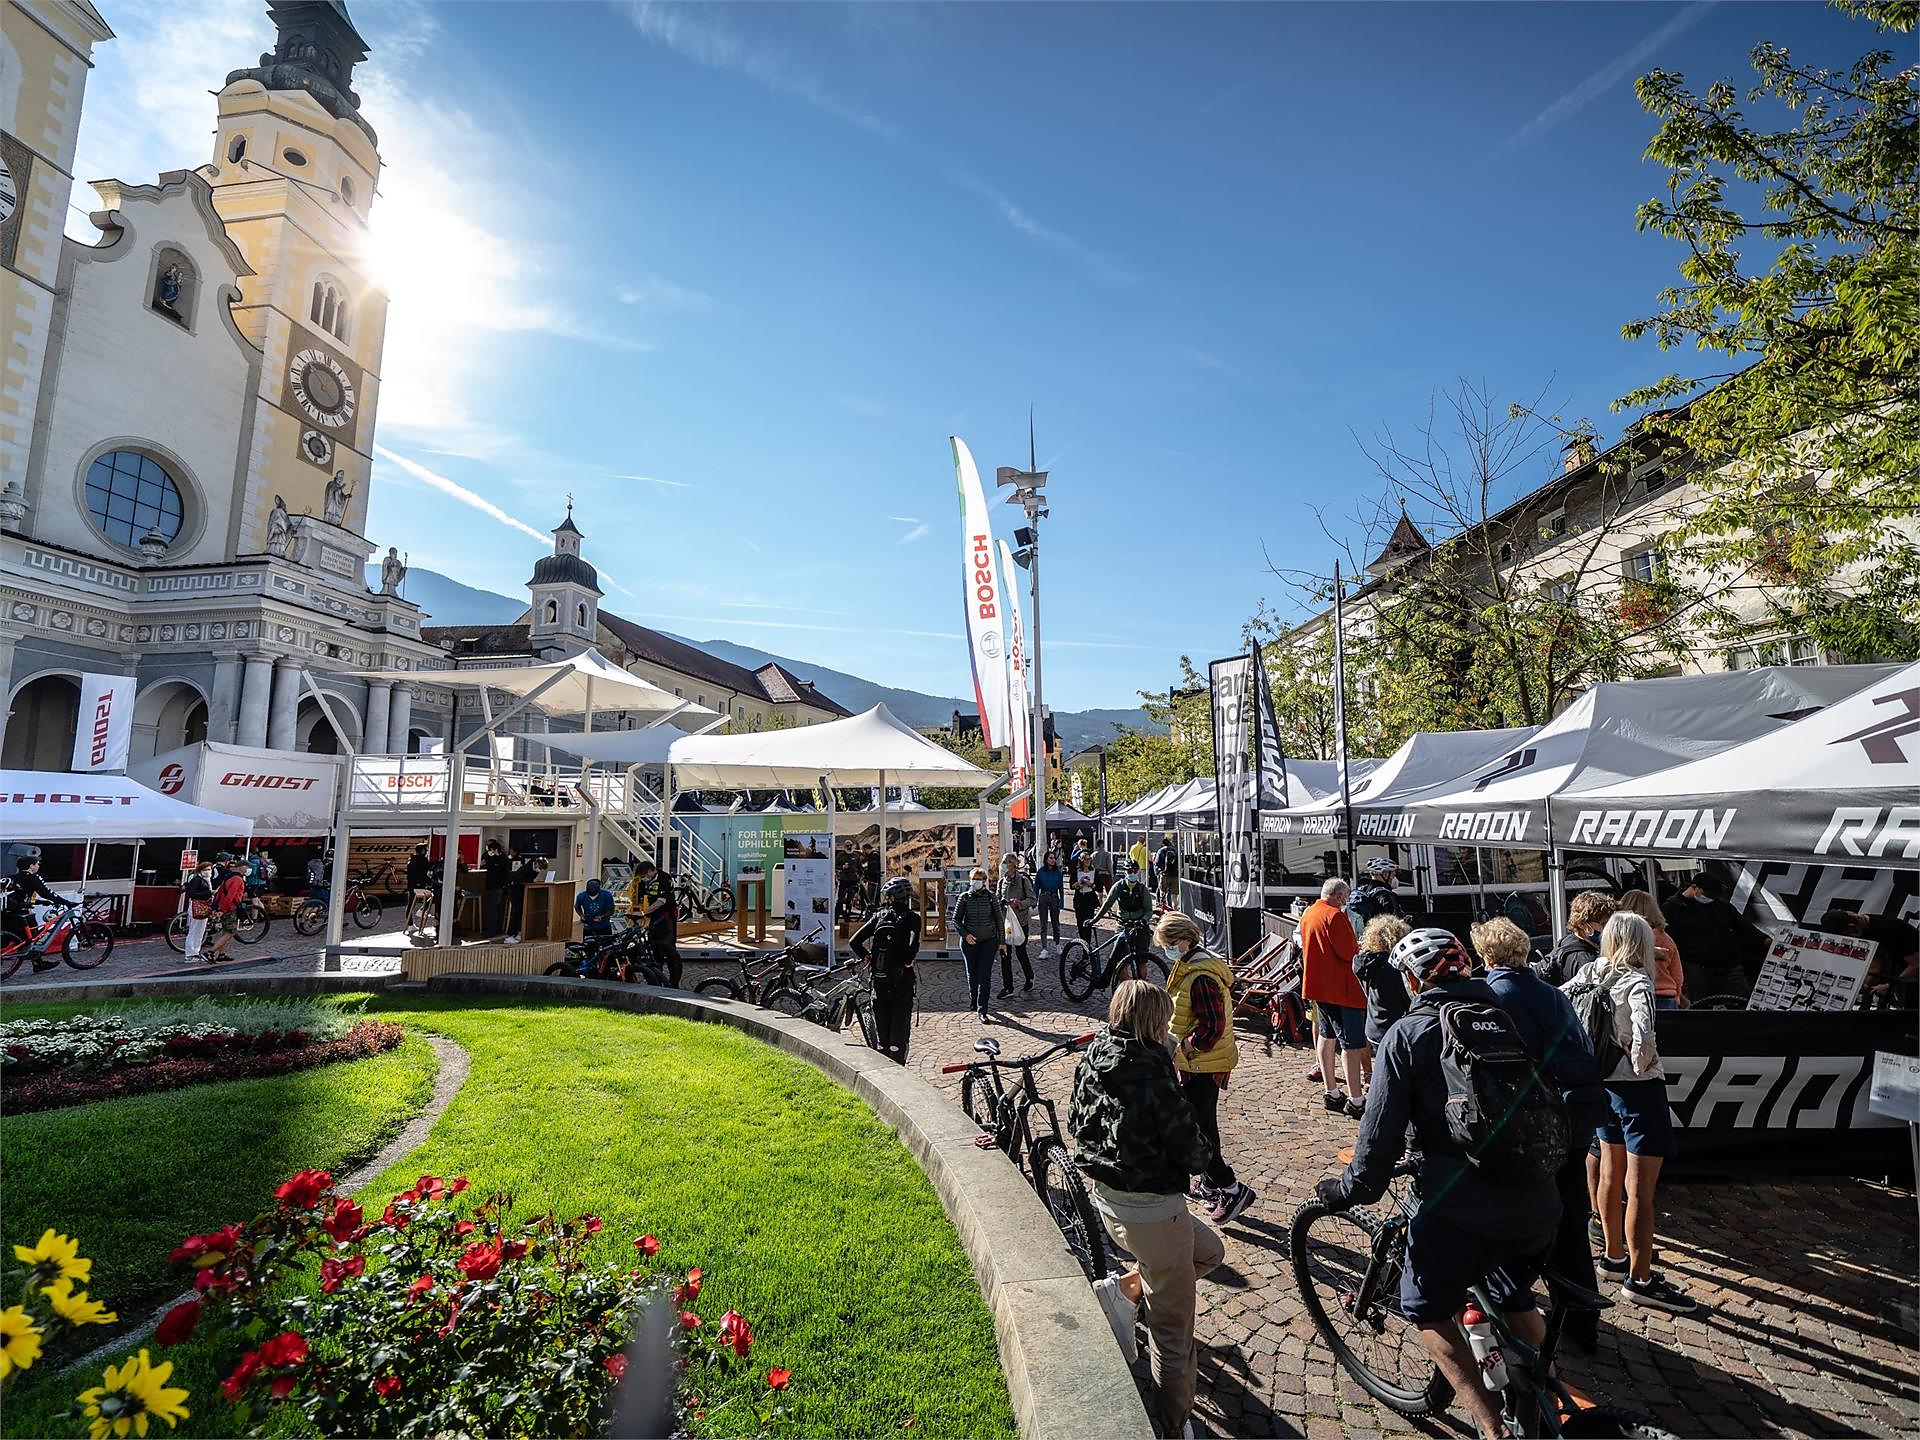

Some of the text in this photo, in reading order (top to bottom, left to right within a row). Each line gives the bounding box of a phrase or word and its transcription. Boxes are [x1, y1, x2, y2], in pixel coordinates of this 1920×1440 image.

[219, 772, 319, 790] GHOST
[387, 775, 433, 788] BOSCH
[0, 793, 139, 805] HOST
[1263, 816, 1292, 834] RADON
[1301, 813, 1342, 835] RADON
[1356, 813, 1416, 837] RADON
[1438, 810, 1532, 841] RADON
[1568, 808, 1738, 850] RADON
[738, 830, 757, 839] FOR
[760, 830, 778, 839] THE
[738, 839, 784, 849] UPHILL FL
